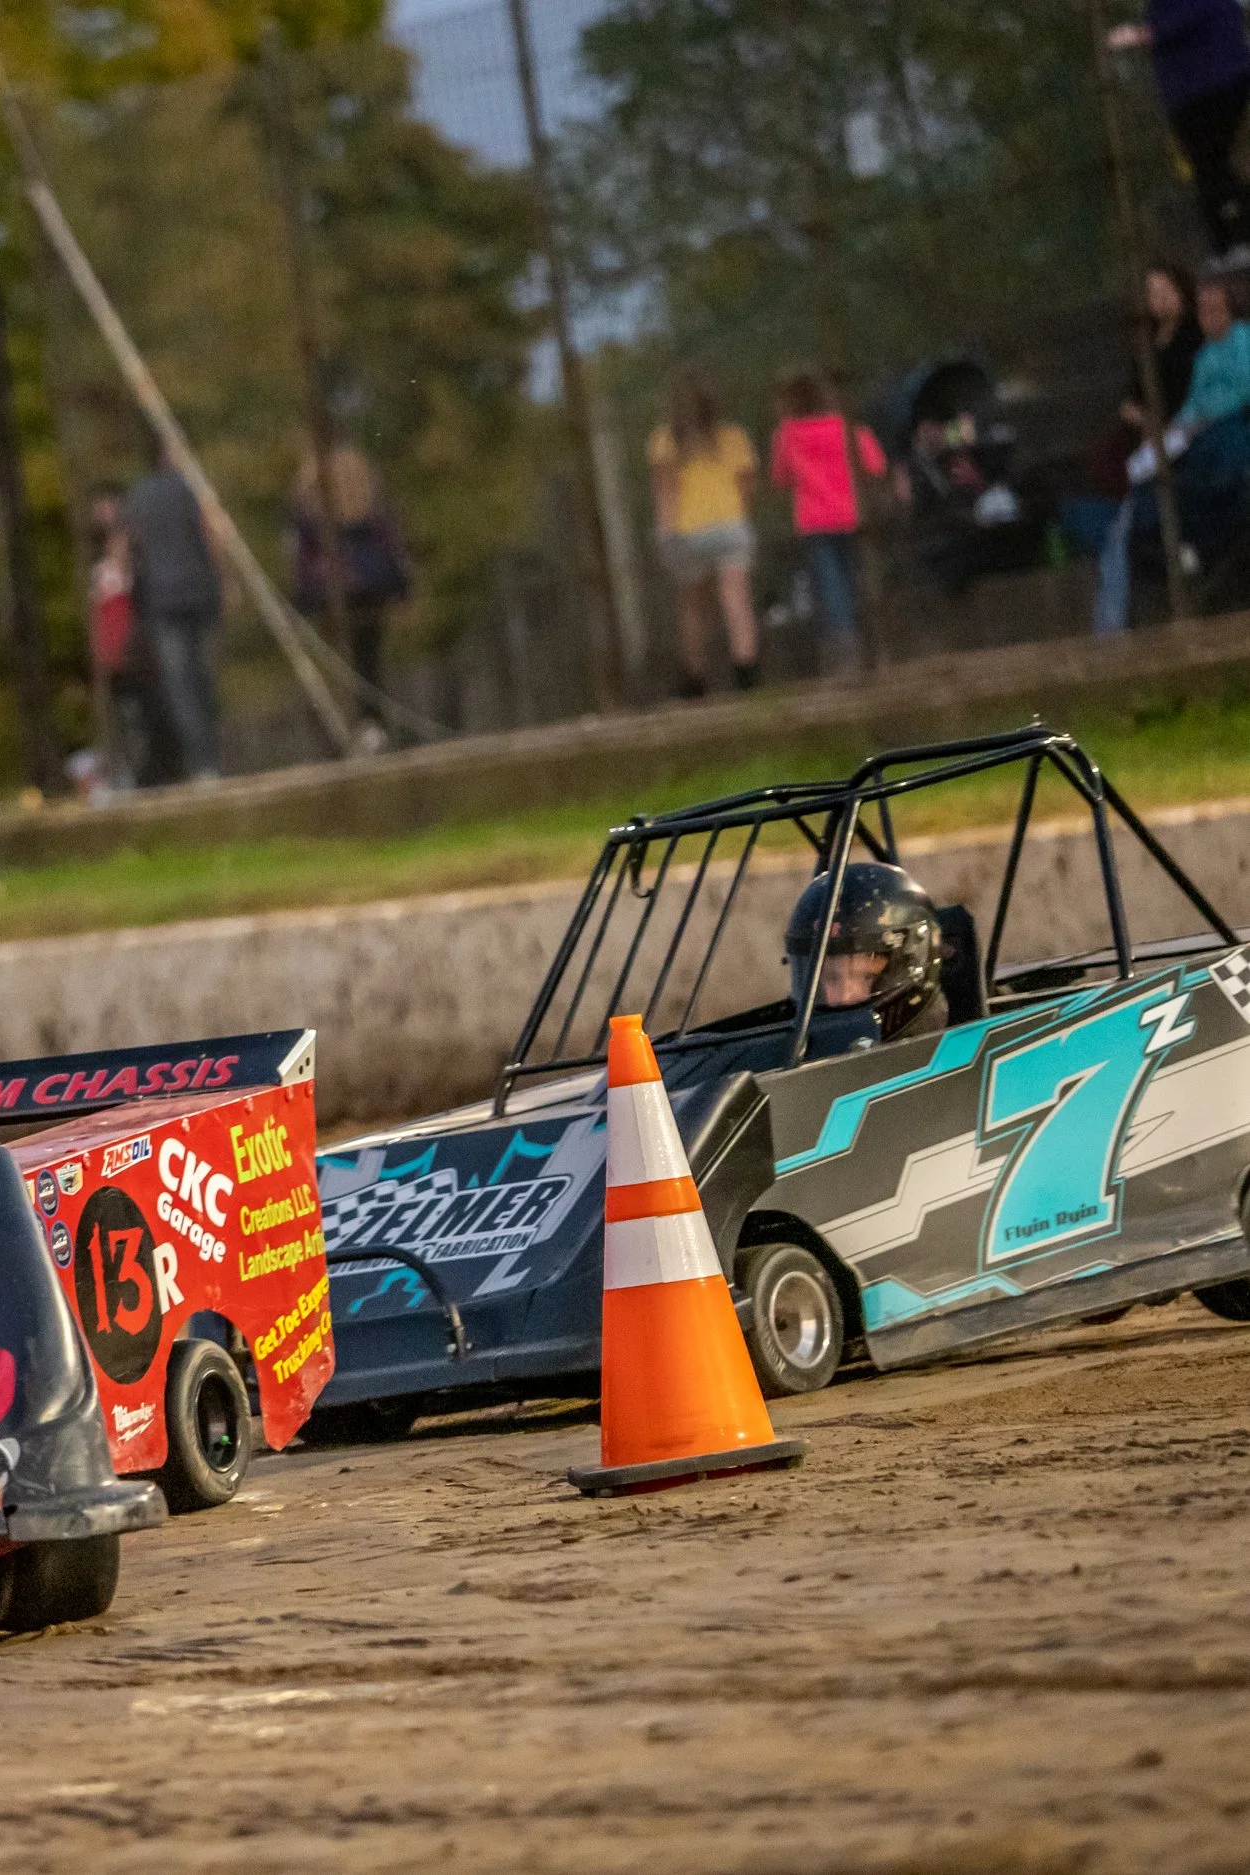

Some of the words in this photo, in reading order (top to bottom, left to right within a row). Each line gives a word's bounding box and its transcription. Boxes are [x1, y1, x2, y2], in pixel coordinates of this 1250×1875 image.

[32, 1055, 241, 1105] CHASSIS
[985, 980, 1176, 1264] 7
[102, 1137, 150, 1176] AMSOIL
[230, 1114, 293, 1184] Exotic
[158, 1137, 234, 1227] CKC
[156, 1192, 227, 1263] Garage
[240, 1197, 295, 1236] Creations
[290, 1184, 316, 1217] LLC
[1004, 1217, 1050, 1241] Flyin
[238, 1240, 304, 1282] Landscape
[430, 1231, 536, 1259] FABRICATION
[88, 1222, 153, 1335] 13
[152, 1242, 185, 1314] R
[254, 1327, 280, 1361] Get
[275, 1308, 301, 1341] Joe
[272, 1325, 323, 1384] Trucking
